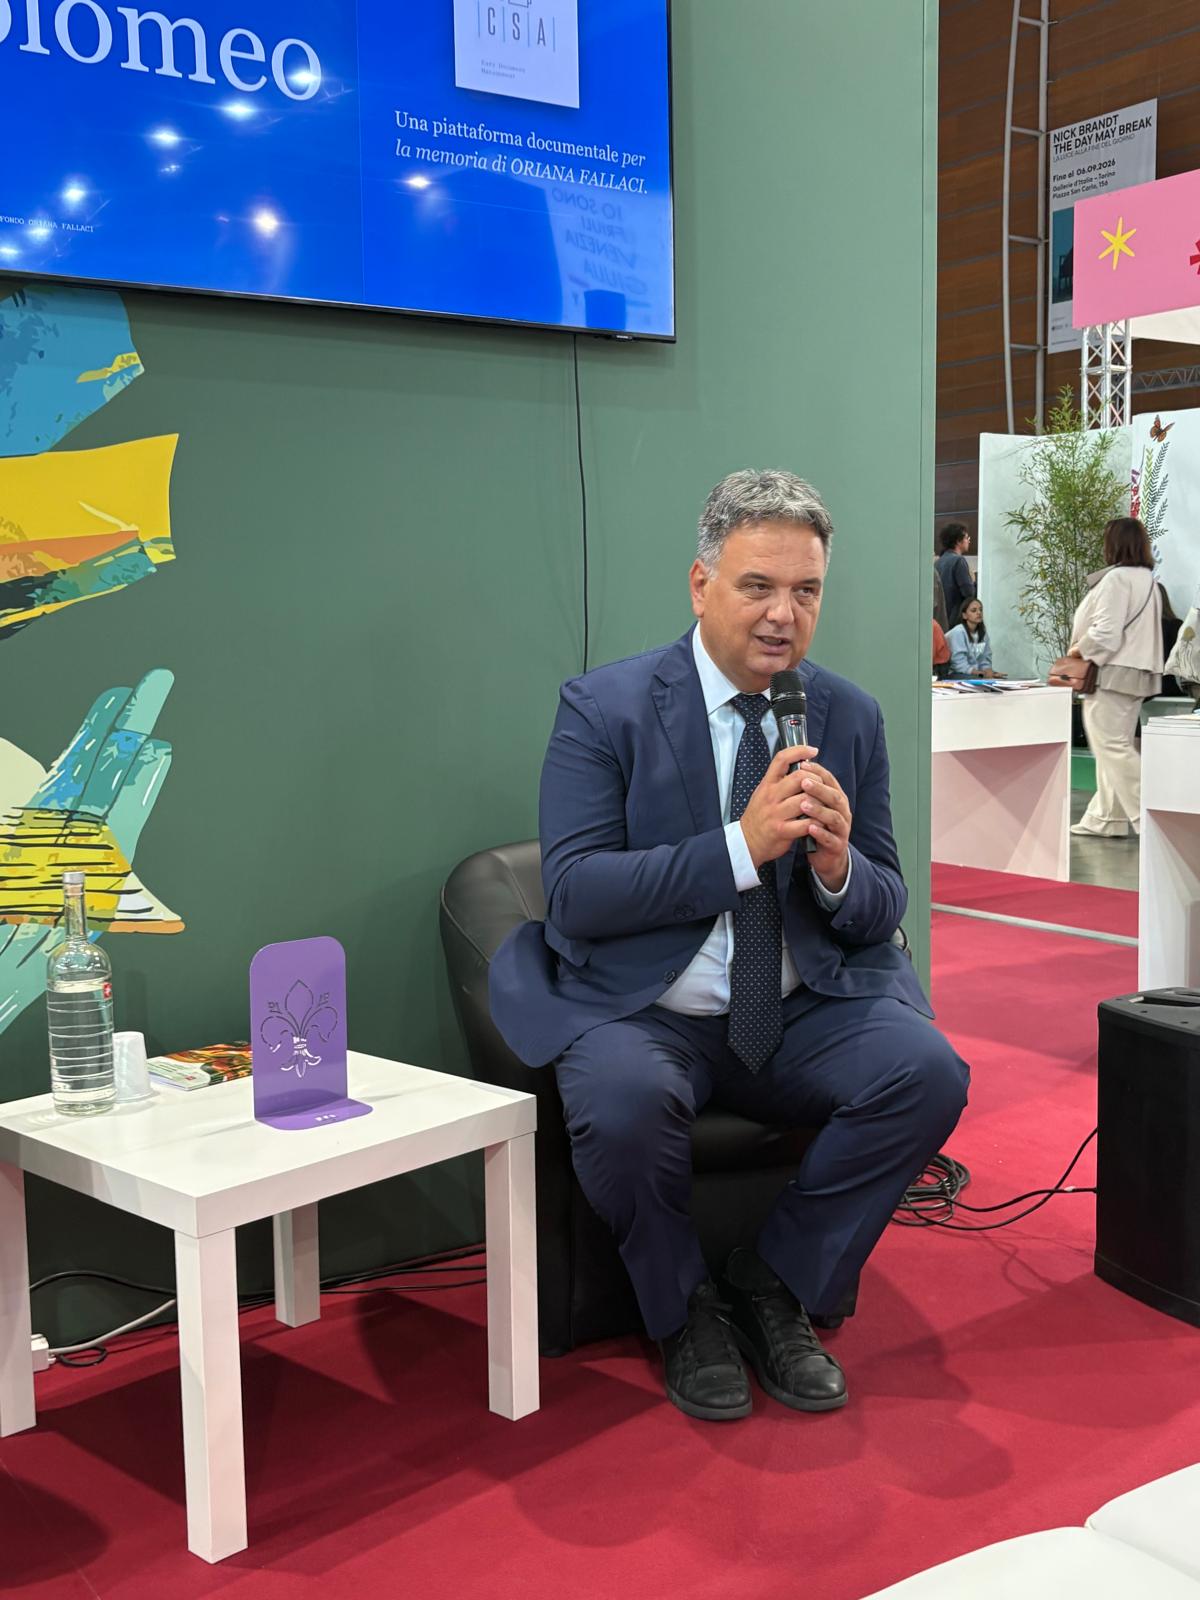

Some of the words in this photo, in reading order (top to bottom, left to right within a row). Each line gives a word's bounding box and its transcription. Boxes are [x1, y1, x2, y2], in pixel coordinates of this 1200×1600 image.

[0, 0, 321, 100] lomeo
[395, 110, 428, 132] Una
[432, 117, 523, 147] piattaforma
[526, 131, 619, 163] documentale
[620, 152, 646, 168] per
[1053, 127, 1077, 144] NICK
[1078, 114, 1119, 137] BRANDT
[1053, 140, 1073, 155] THE
[1074, 133, 1094, 149] DAY
[1095, 127, 1117, 143] MAY
[1118, 115, 1152, 135] BREAK
[395, 138, 411, 158] la
[416, 147, 488, 170] memoria
[492, 154, 507, 173] di
[511, 158, 575, 183] ORIANA
[578, 169, 648, 194] FALLACI.
[1076, 158, 1116, 176] 06.09.2026
